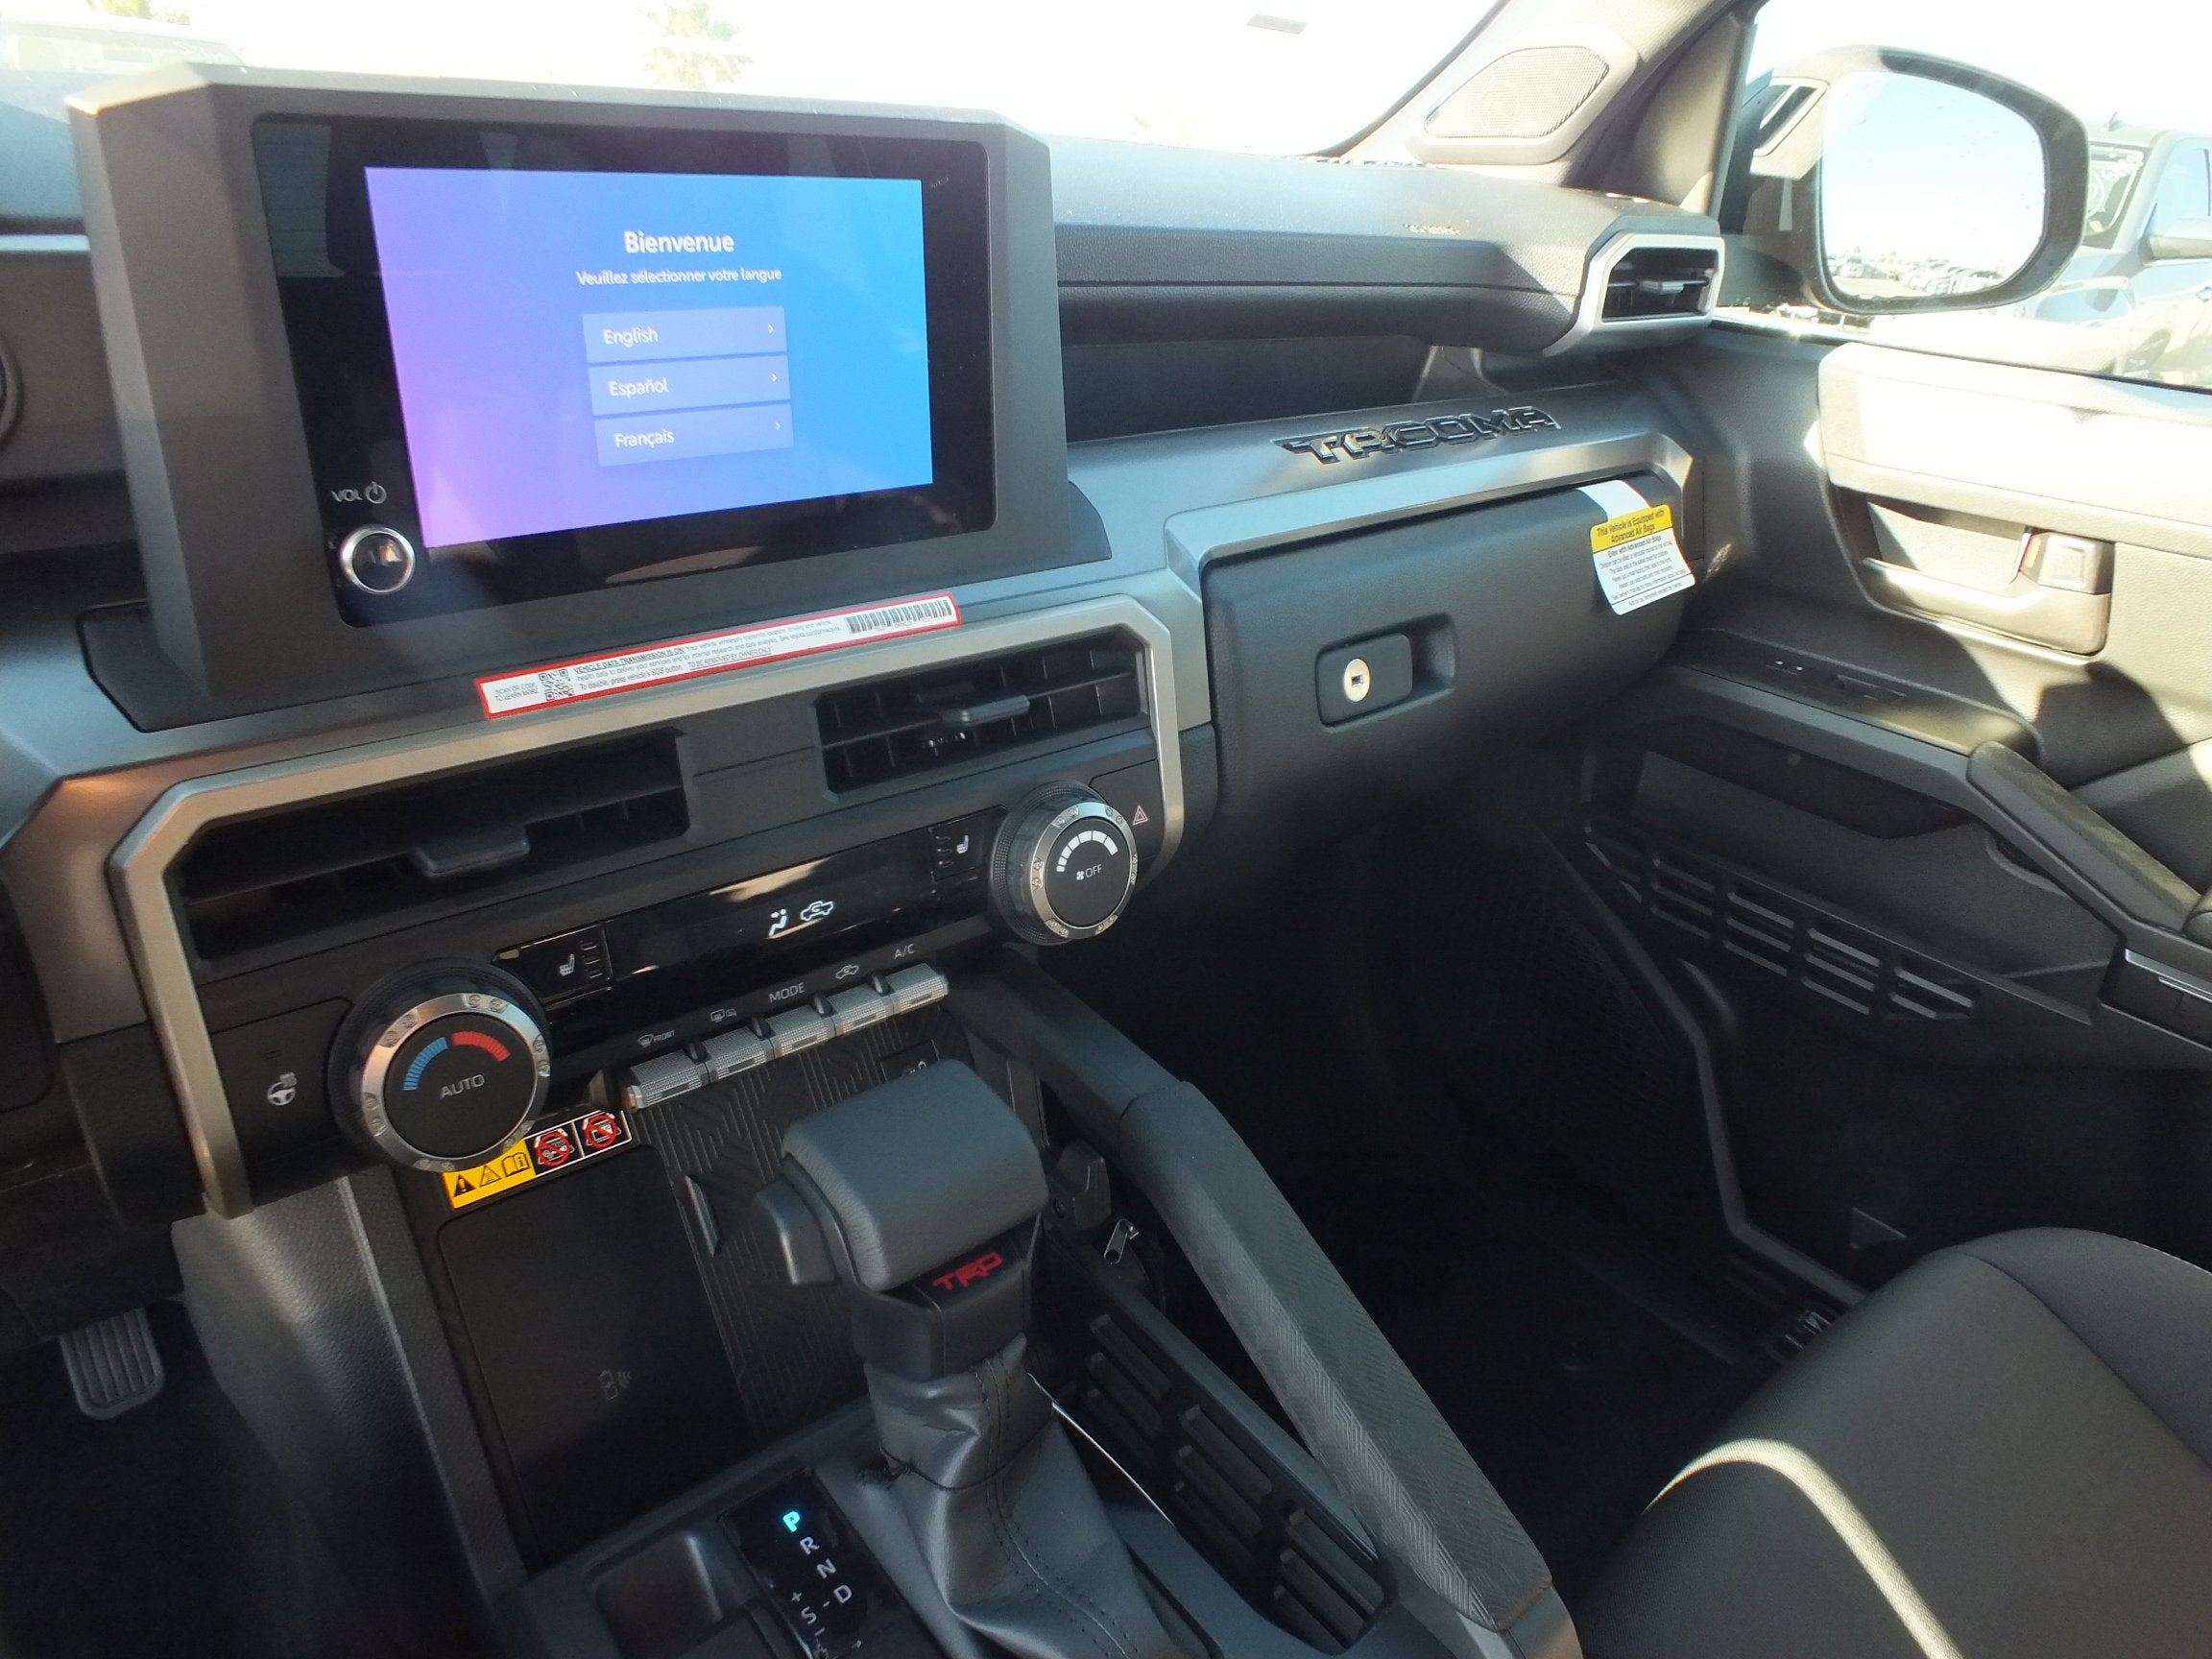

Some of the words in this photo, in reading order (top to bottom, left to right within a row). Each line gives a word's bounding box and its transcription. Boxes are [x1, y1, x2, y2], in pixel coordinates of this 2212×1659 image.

[624, 230, 734, 253] Bienvenue
[576, 270, 629, 285] Veuillez
[631, 269, 706, 284] sélectionner
[709, 269, 739, 282] votre
[741, 267, 782, 283] langue
[603, 326, 659, 348] English
[609, 377, 669, 398] Español
[614, 429, 675, 448] Français
[1270, 405, 1562, 466] TACOMA
[330, 489, 363, 502] VOL
[1597, 527, 1608, 538] This
[1609, 521, 1627, 533] Vehicle
[1632, 513, 1655, 526] Equipped
[1655, 509, 1665, 517] with
[1611, 530, 1635, 543] Advanced
[1643, 524, 1655, 534] Bags
[574, 663, 602, 674] VEHICLE
[603, 660, 619, 669] DATA
[620, 649, 666, 665] TRANSMISSION
[1085, 865, 1102, 878] OFF
[895, 944, 915, 959] A/C
[769, 982, 805, 1003] MODE
[441, 1074, 485, 1099] AUTO
[932, 1252, 1003, 1290] TRD
[782, 1511, 801, 1532] P
[800, 1536, 820, 1555] R
[816, 1558, 837, 1578] N
[833, 1584, 852, 1603] D
[801, 1606, 817, 1624] S
